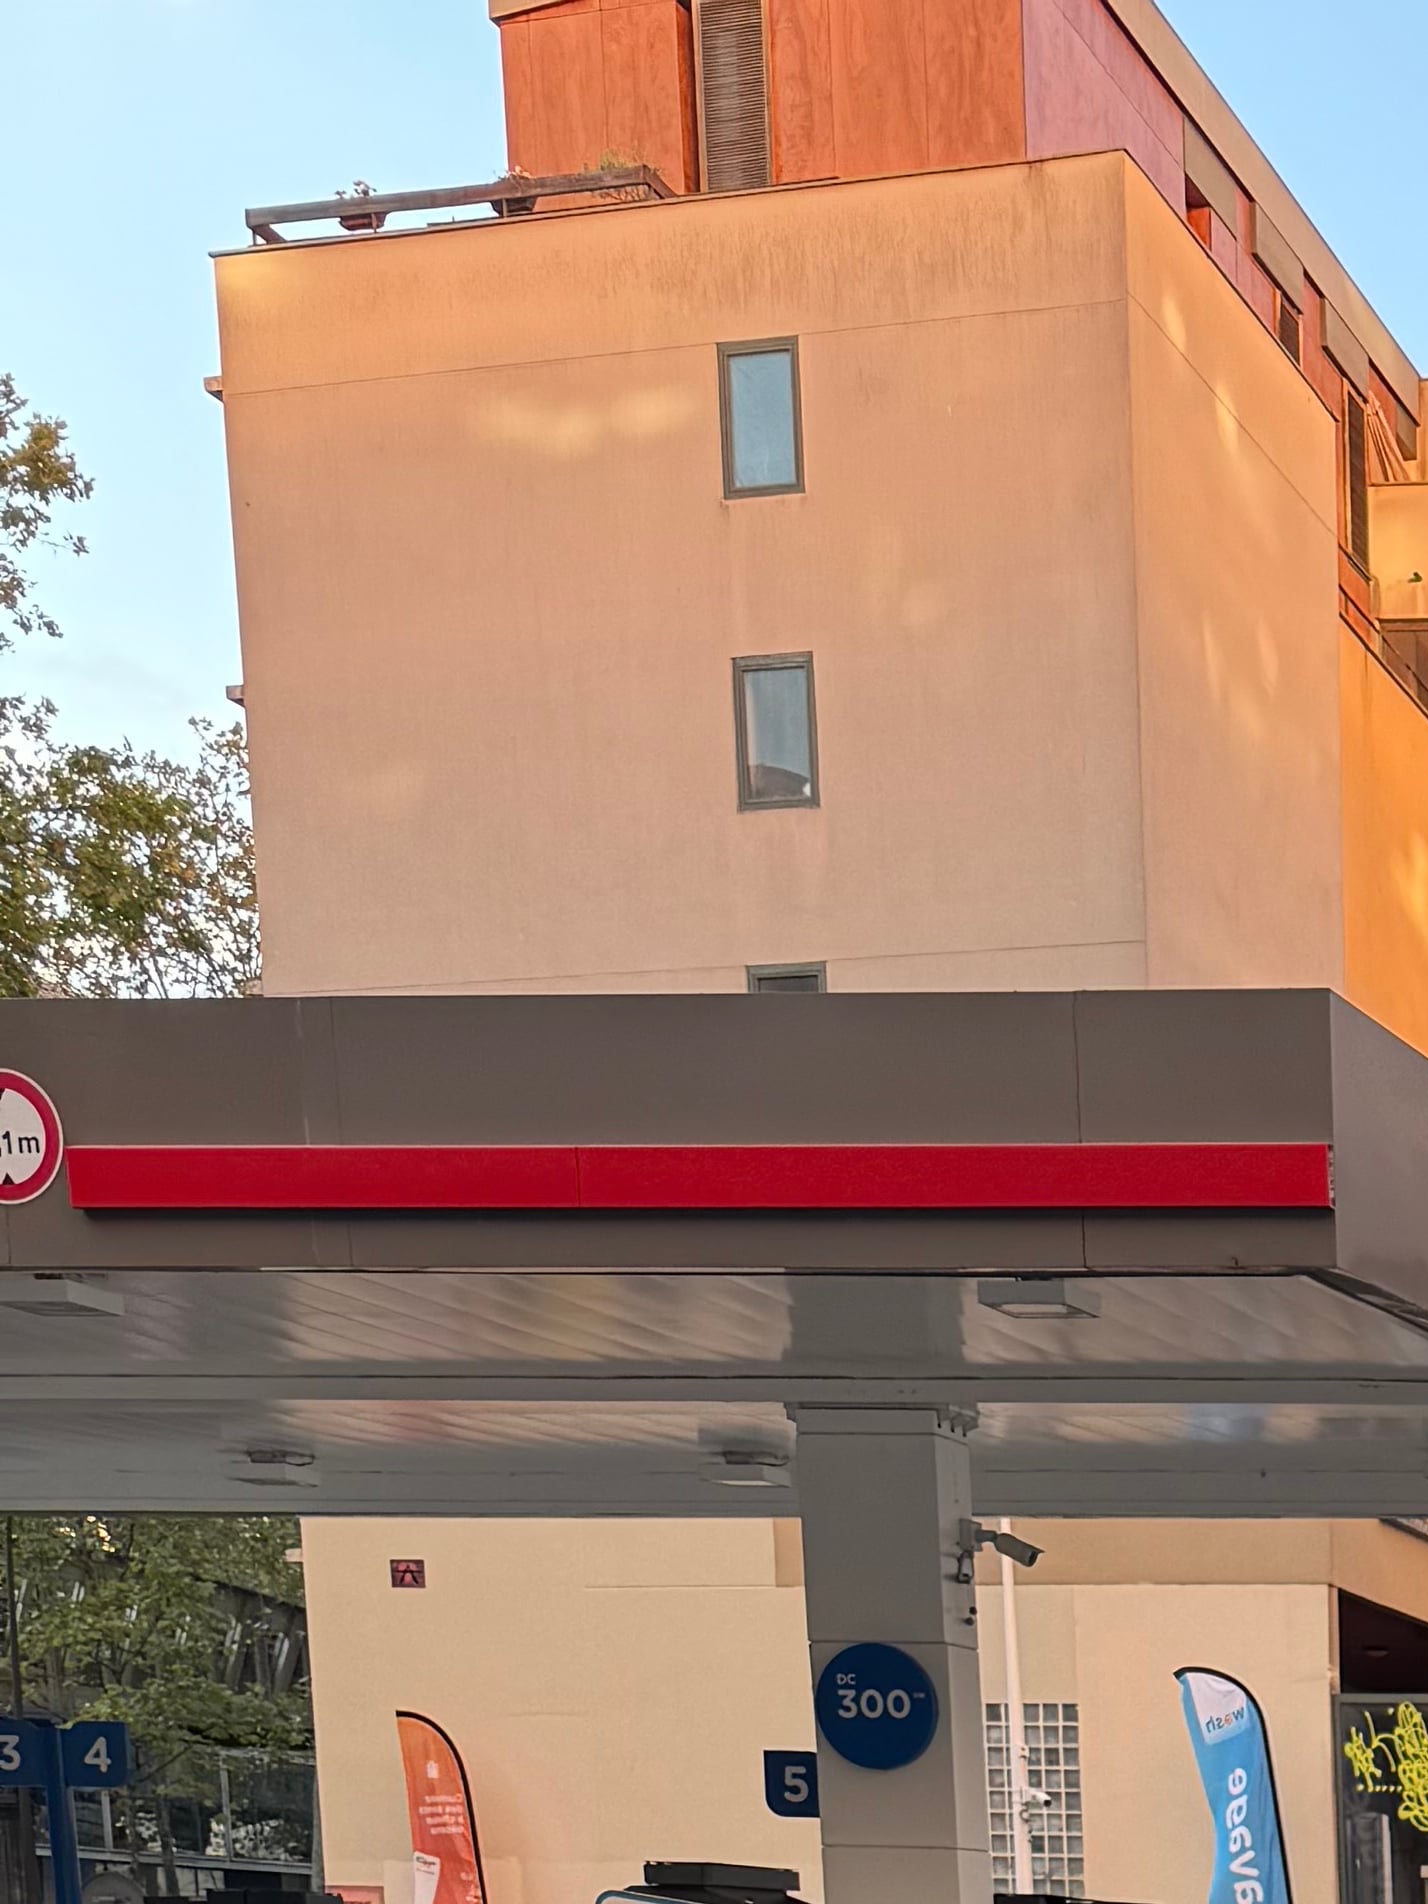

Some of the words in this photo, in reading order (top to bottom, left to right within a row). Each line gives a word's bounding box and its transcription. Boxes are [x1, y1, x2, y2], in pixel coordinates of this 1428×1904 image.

[836, 1674, 856, 1685] DC
[837, 1689, 911, 1719] 300
[0, 1735, 21, 1771] 3
[84, 1737, 112, 1773] 4
[784, 1766, 809, 1803] 5
